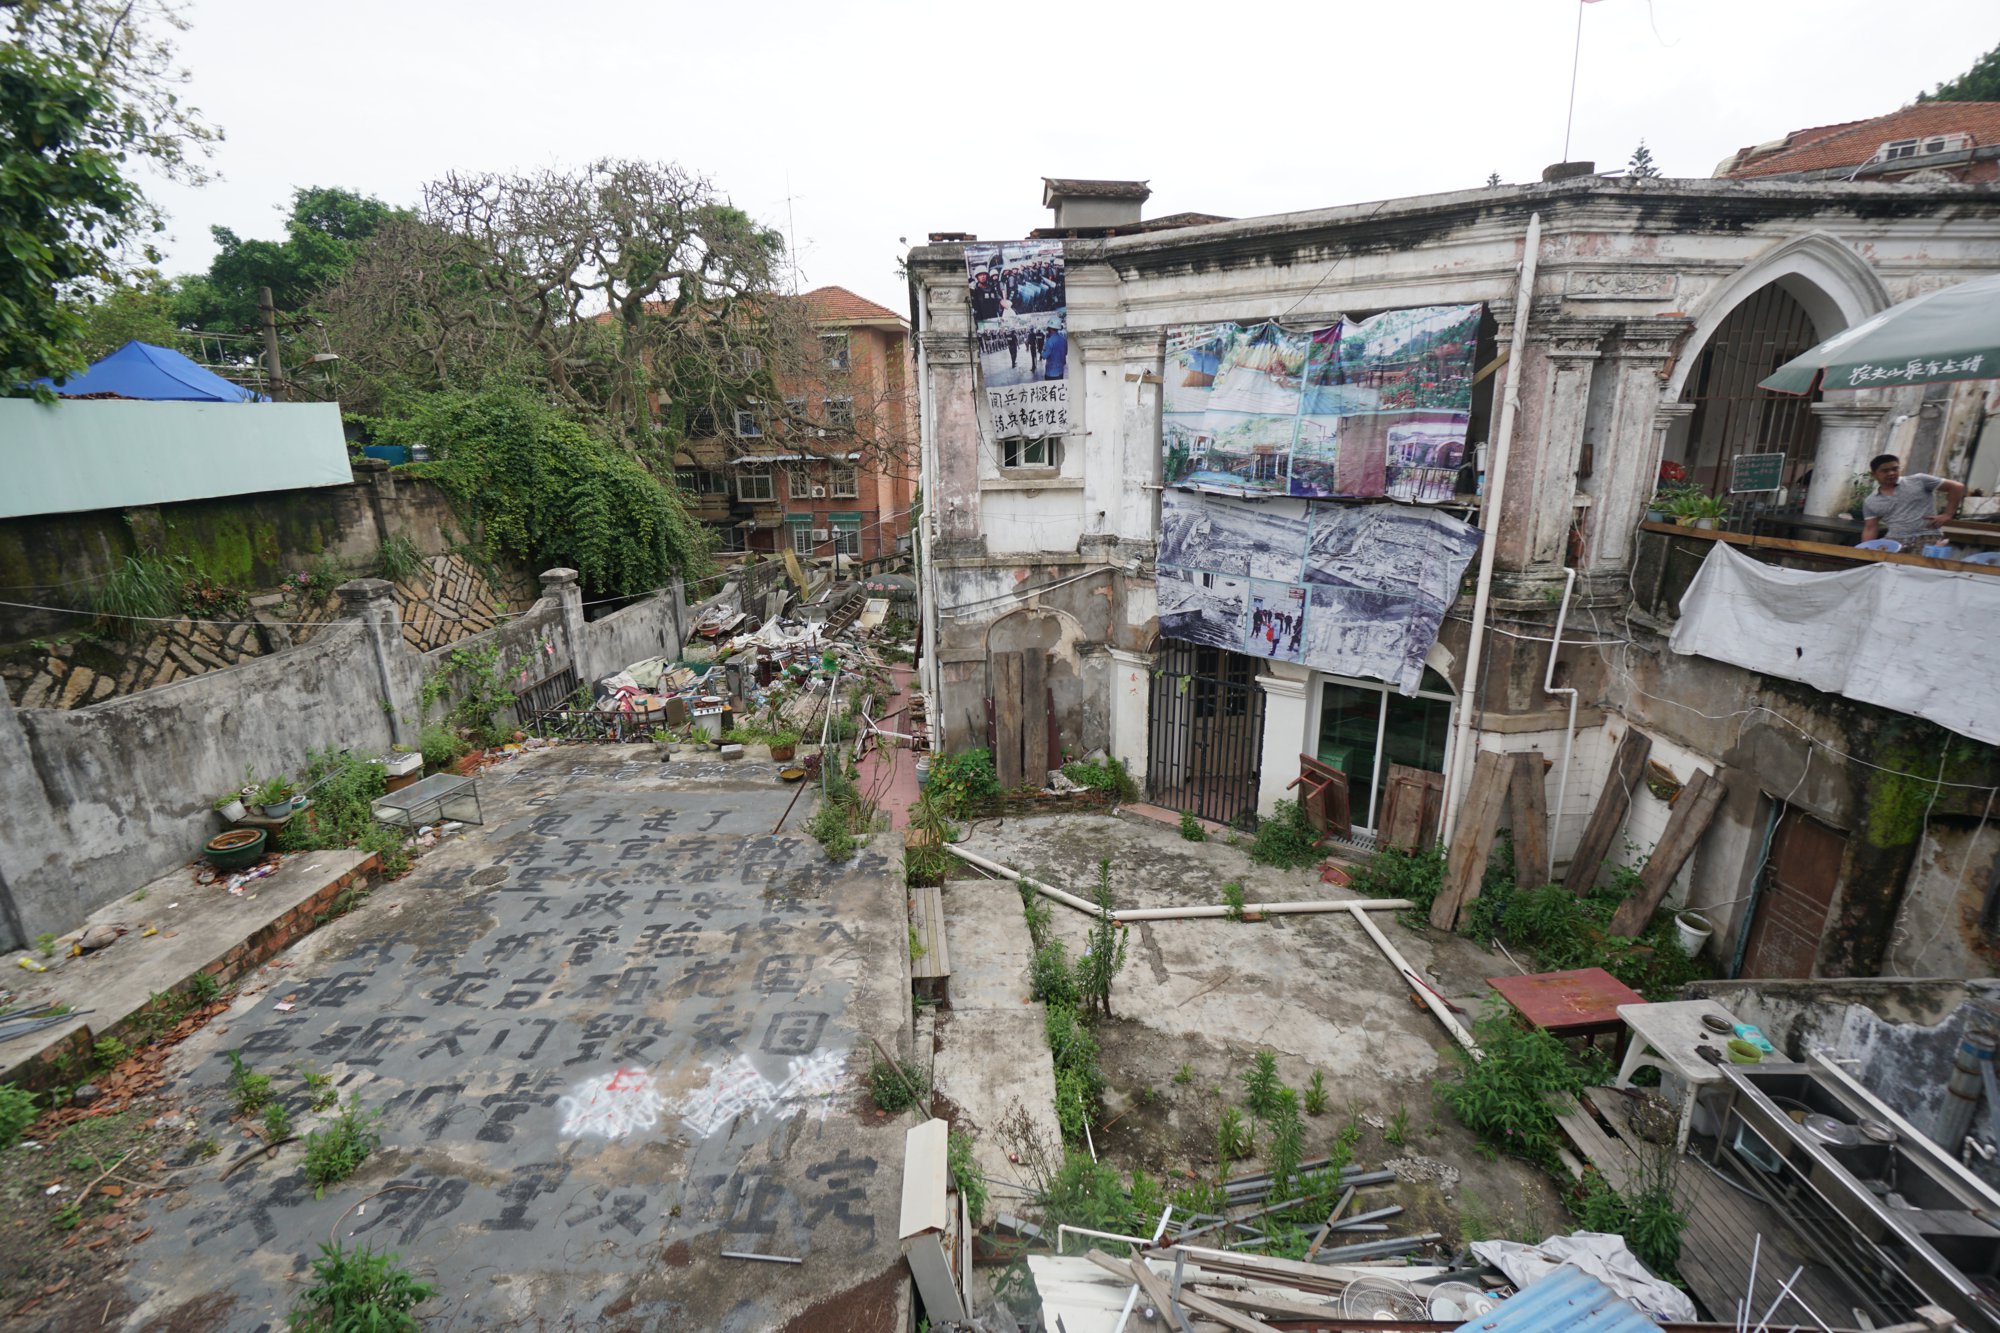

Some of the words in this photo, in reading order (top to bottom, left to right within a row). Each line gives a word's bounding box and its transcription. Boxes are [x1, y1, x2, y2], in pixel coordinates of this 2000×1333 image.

[1849, 355, 1984, 386] 农夫山泉有点甜
